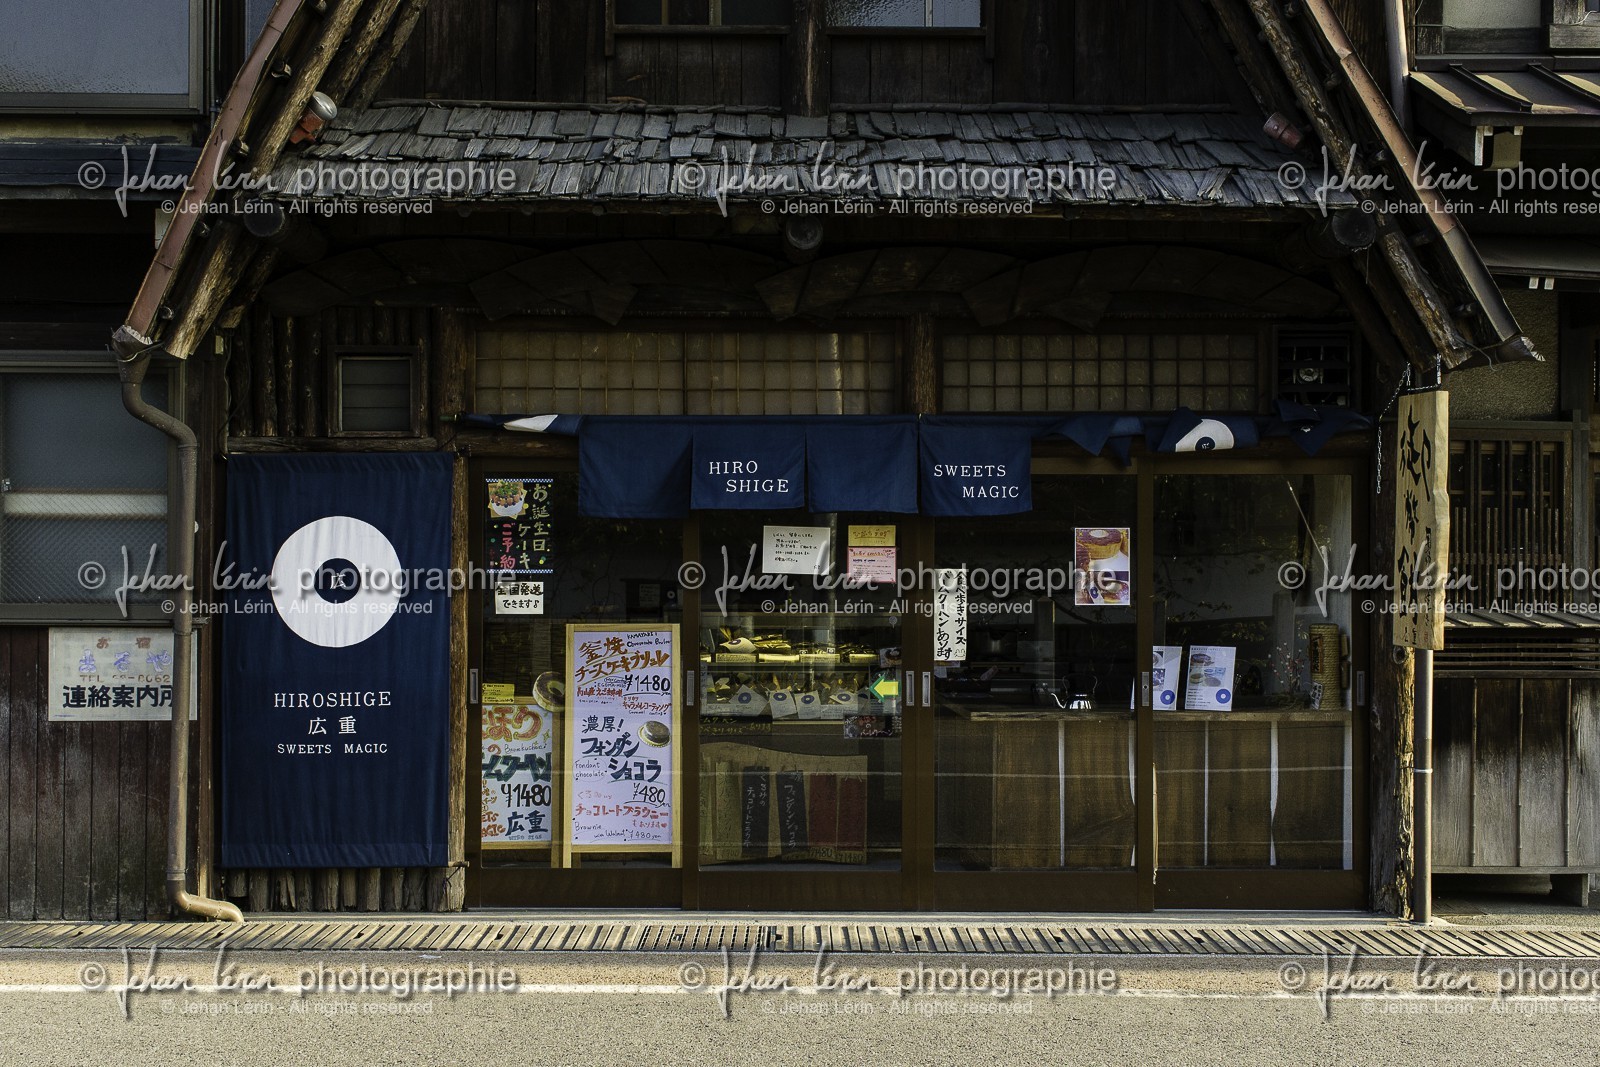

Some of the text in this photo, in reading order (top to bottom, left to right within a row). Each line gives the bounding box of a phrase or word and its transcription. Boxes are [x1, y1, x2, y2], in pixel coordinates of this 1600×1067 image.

[709, 460, 758, 475] HIRO
[933, 464, 1006, 478] SWEETS
[726, 479, 789, 494] SHIGE
[962, 486, 1020, 498] MAGIC
[532, 484, 550, 551] お誕生日
[500, 522, 516, 569] ご予約
[518, 523, 531, 570] ケーキ
[495, 582, 544, 596] 全国発送
[273, 691, 393, 708] HIROSHIGE
[308, 715, 357, 735] 広重
[277, 743, 388, 754] SWEETS MAGIC
[608, 758, 662, 783] ショコラ
[504, 809, 549, 836] 広重
